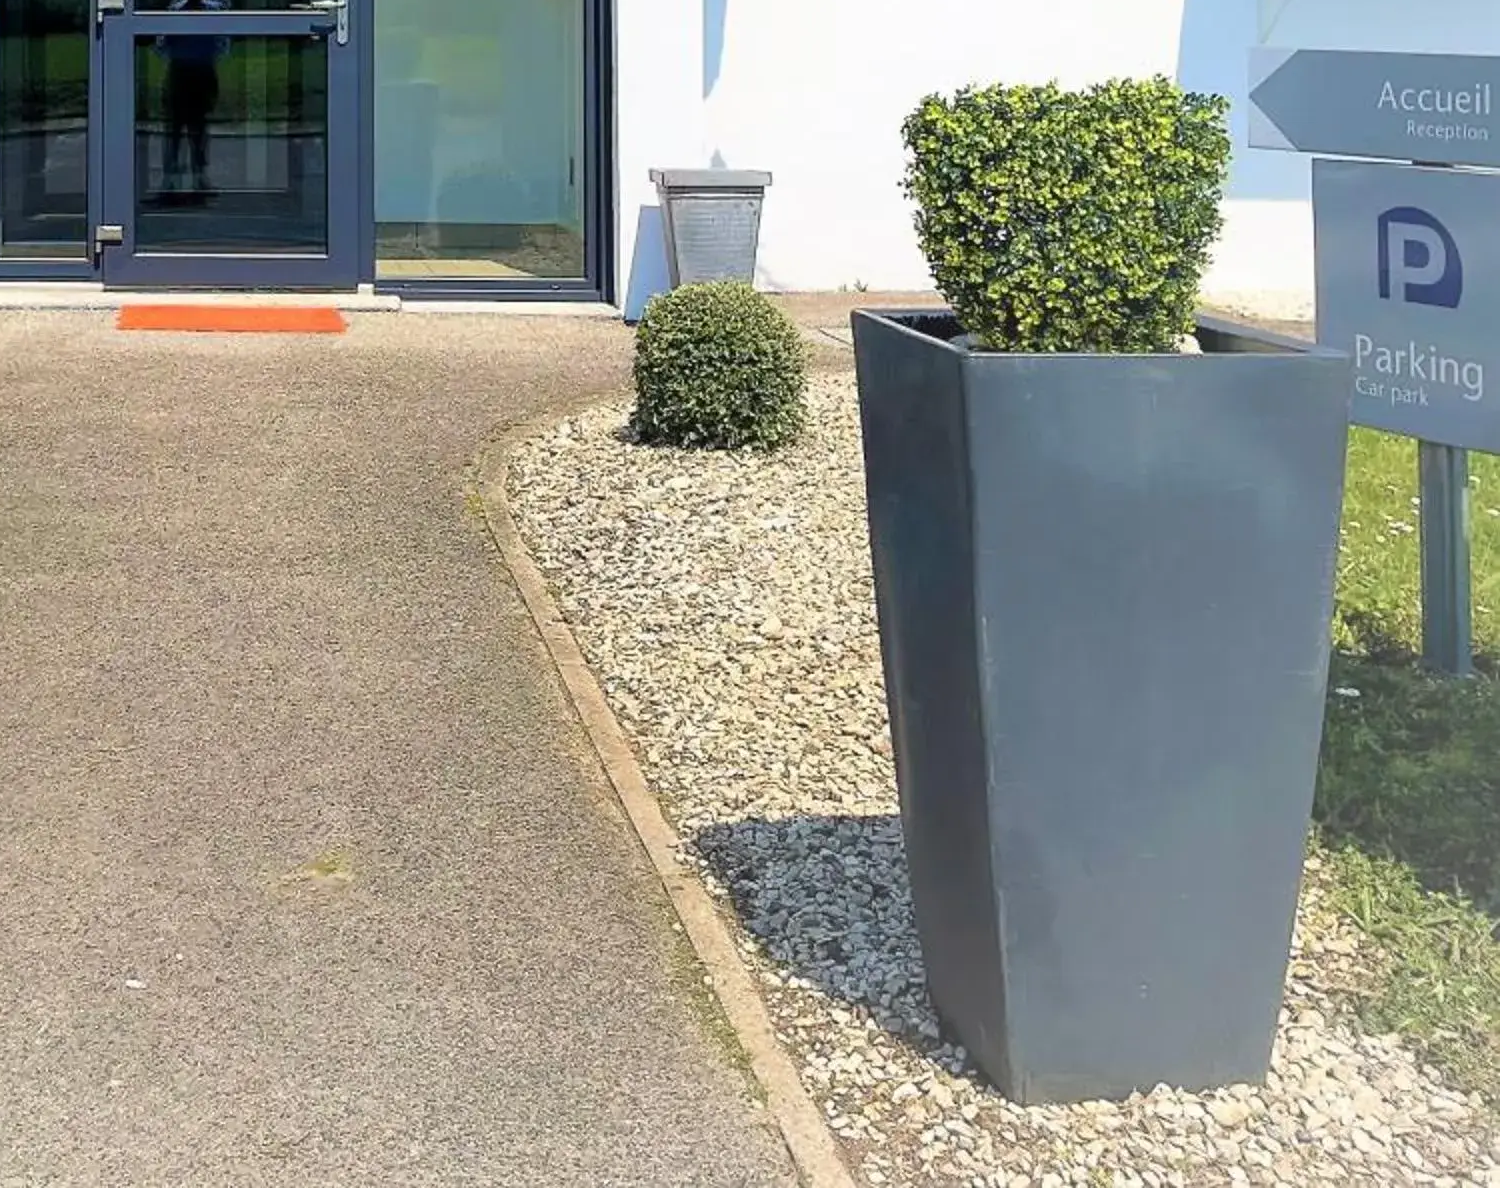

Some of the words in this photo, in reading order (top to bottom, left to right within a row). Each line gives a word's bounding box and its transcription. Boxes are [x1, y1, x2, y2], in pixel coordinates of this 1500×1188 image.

[1377, 80, 1491, 115] Accueil
[1406, 119, 1489, 142] Reception
[1387, 220, 1448, 305] P
[1354, 334, 1484, 401] Parking
[1354, 376, 1384, 398] Car
[1390, 383, 1430, 407] park
